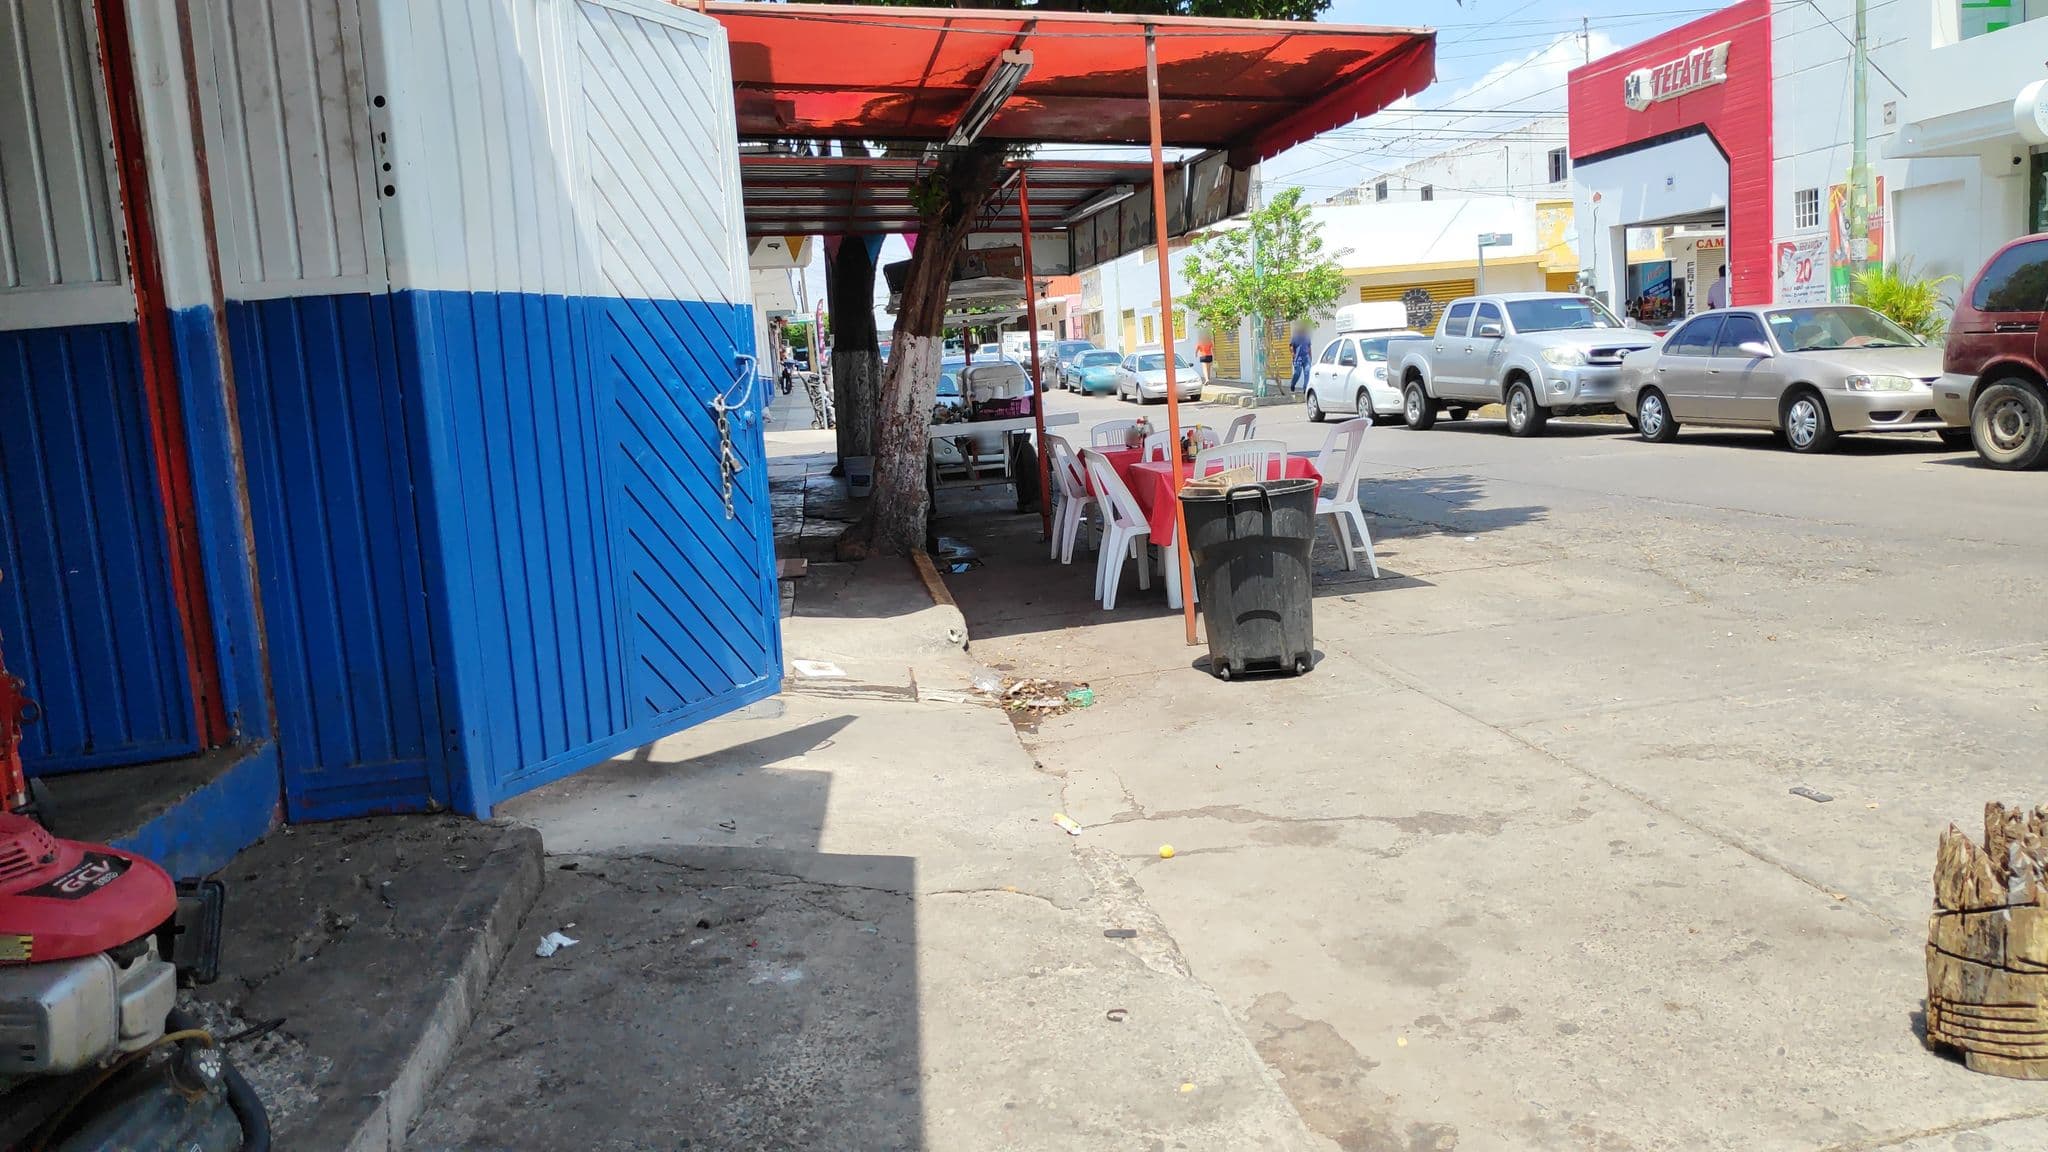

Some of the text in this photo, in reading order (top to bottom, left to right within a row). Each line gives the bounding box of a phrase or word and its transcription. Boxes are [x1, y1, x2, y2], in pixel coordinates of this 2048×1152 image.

[1650, 49, 1714, 97] TECATE
[1696, 238, 1725, 249] CAM
[1795, 258, 1812, 283] 20
[61, 860, 111, 892] GCV
